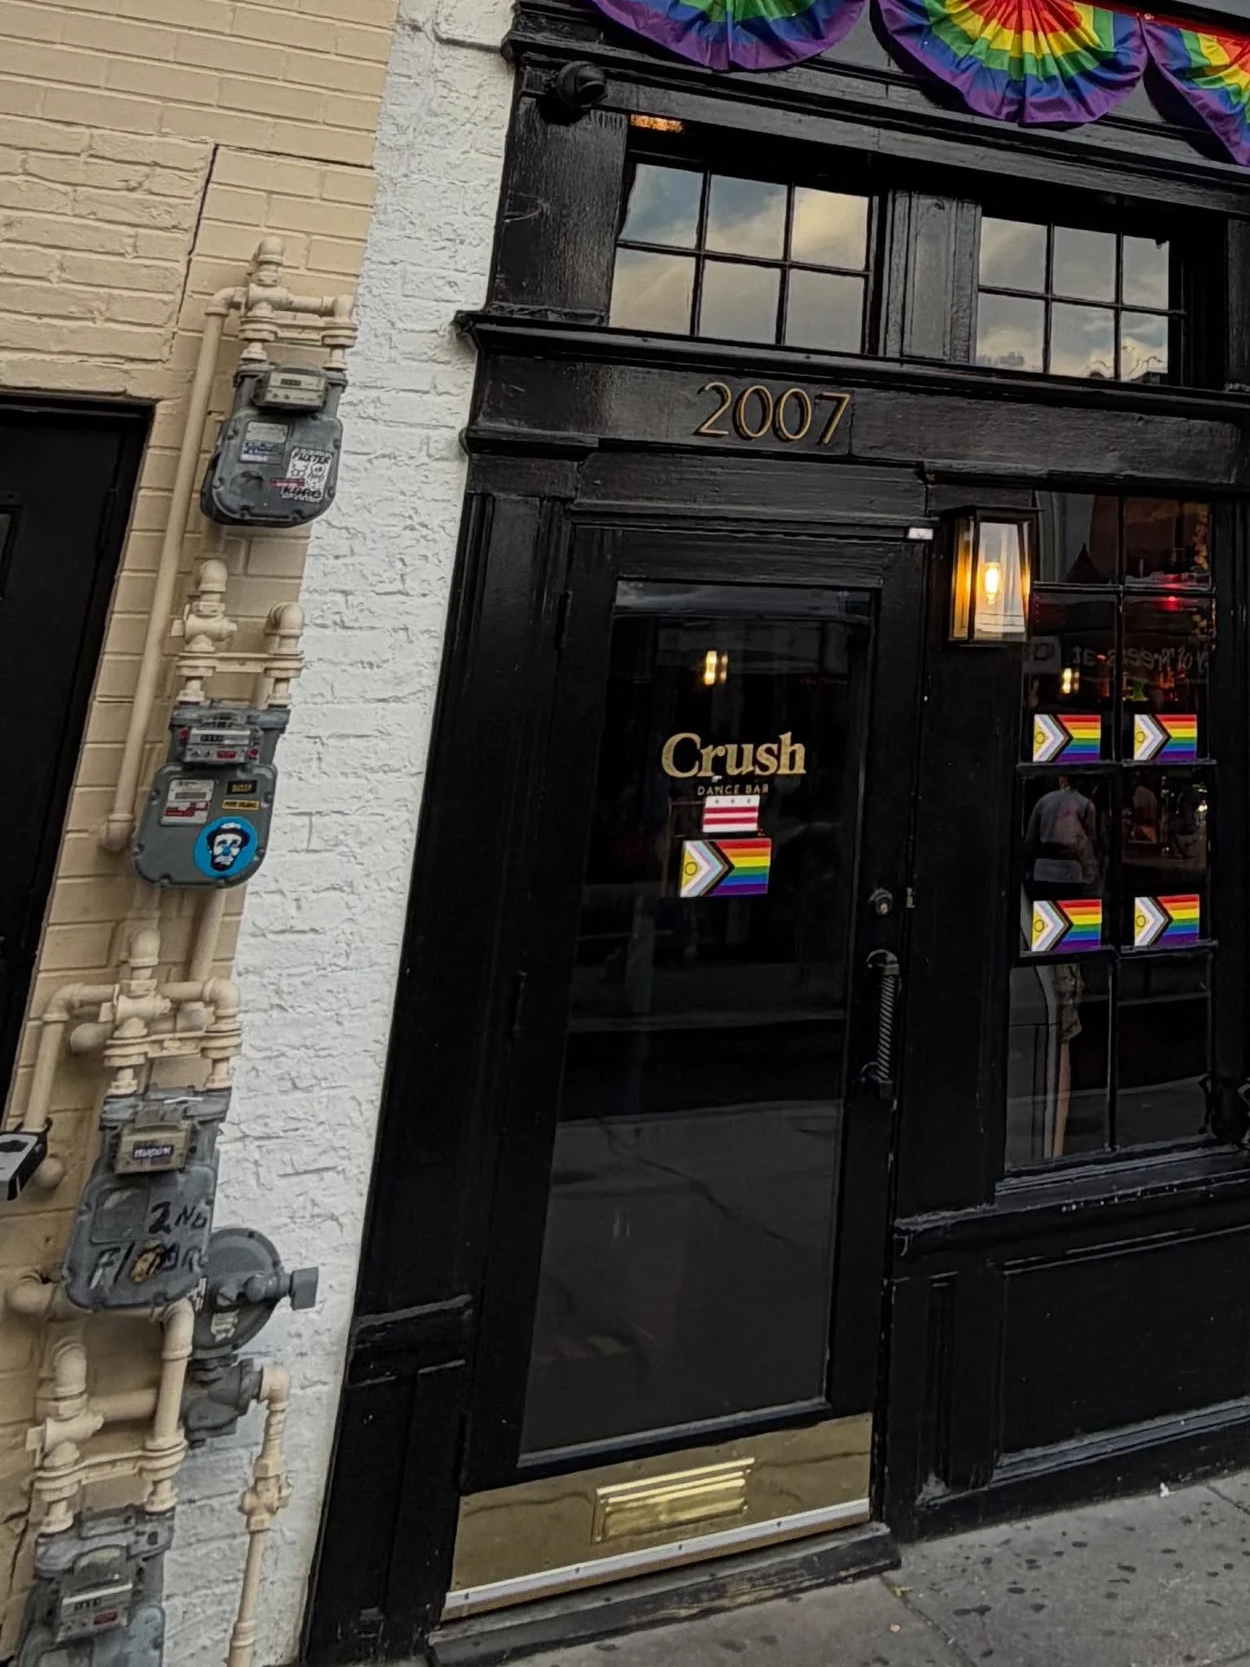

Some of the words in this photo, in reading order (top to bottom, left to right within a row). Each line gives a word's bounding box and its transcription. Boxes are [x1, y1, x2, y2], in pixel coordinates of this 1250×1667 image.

[694, 381, 851, 445] 2007
[661, 731, 807, 778] Crush
[697, 784, 740, 797] DANCE
[745, 783, 770, 795] BAR
